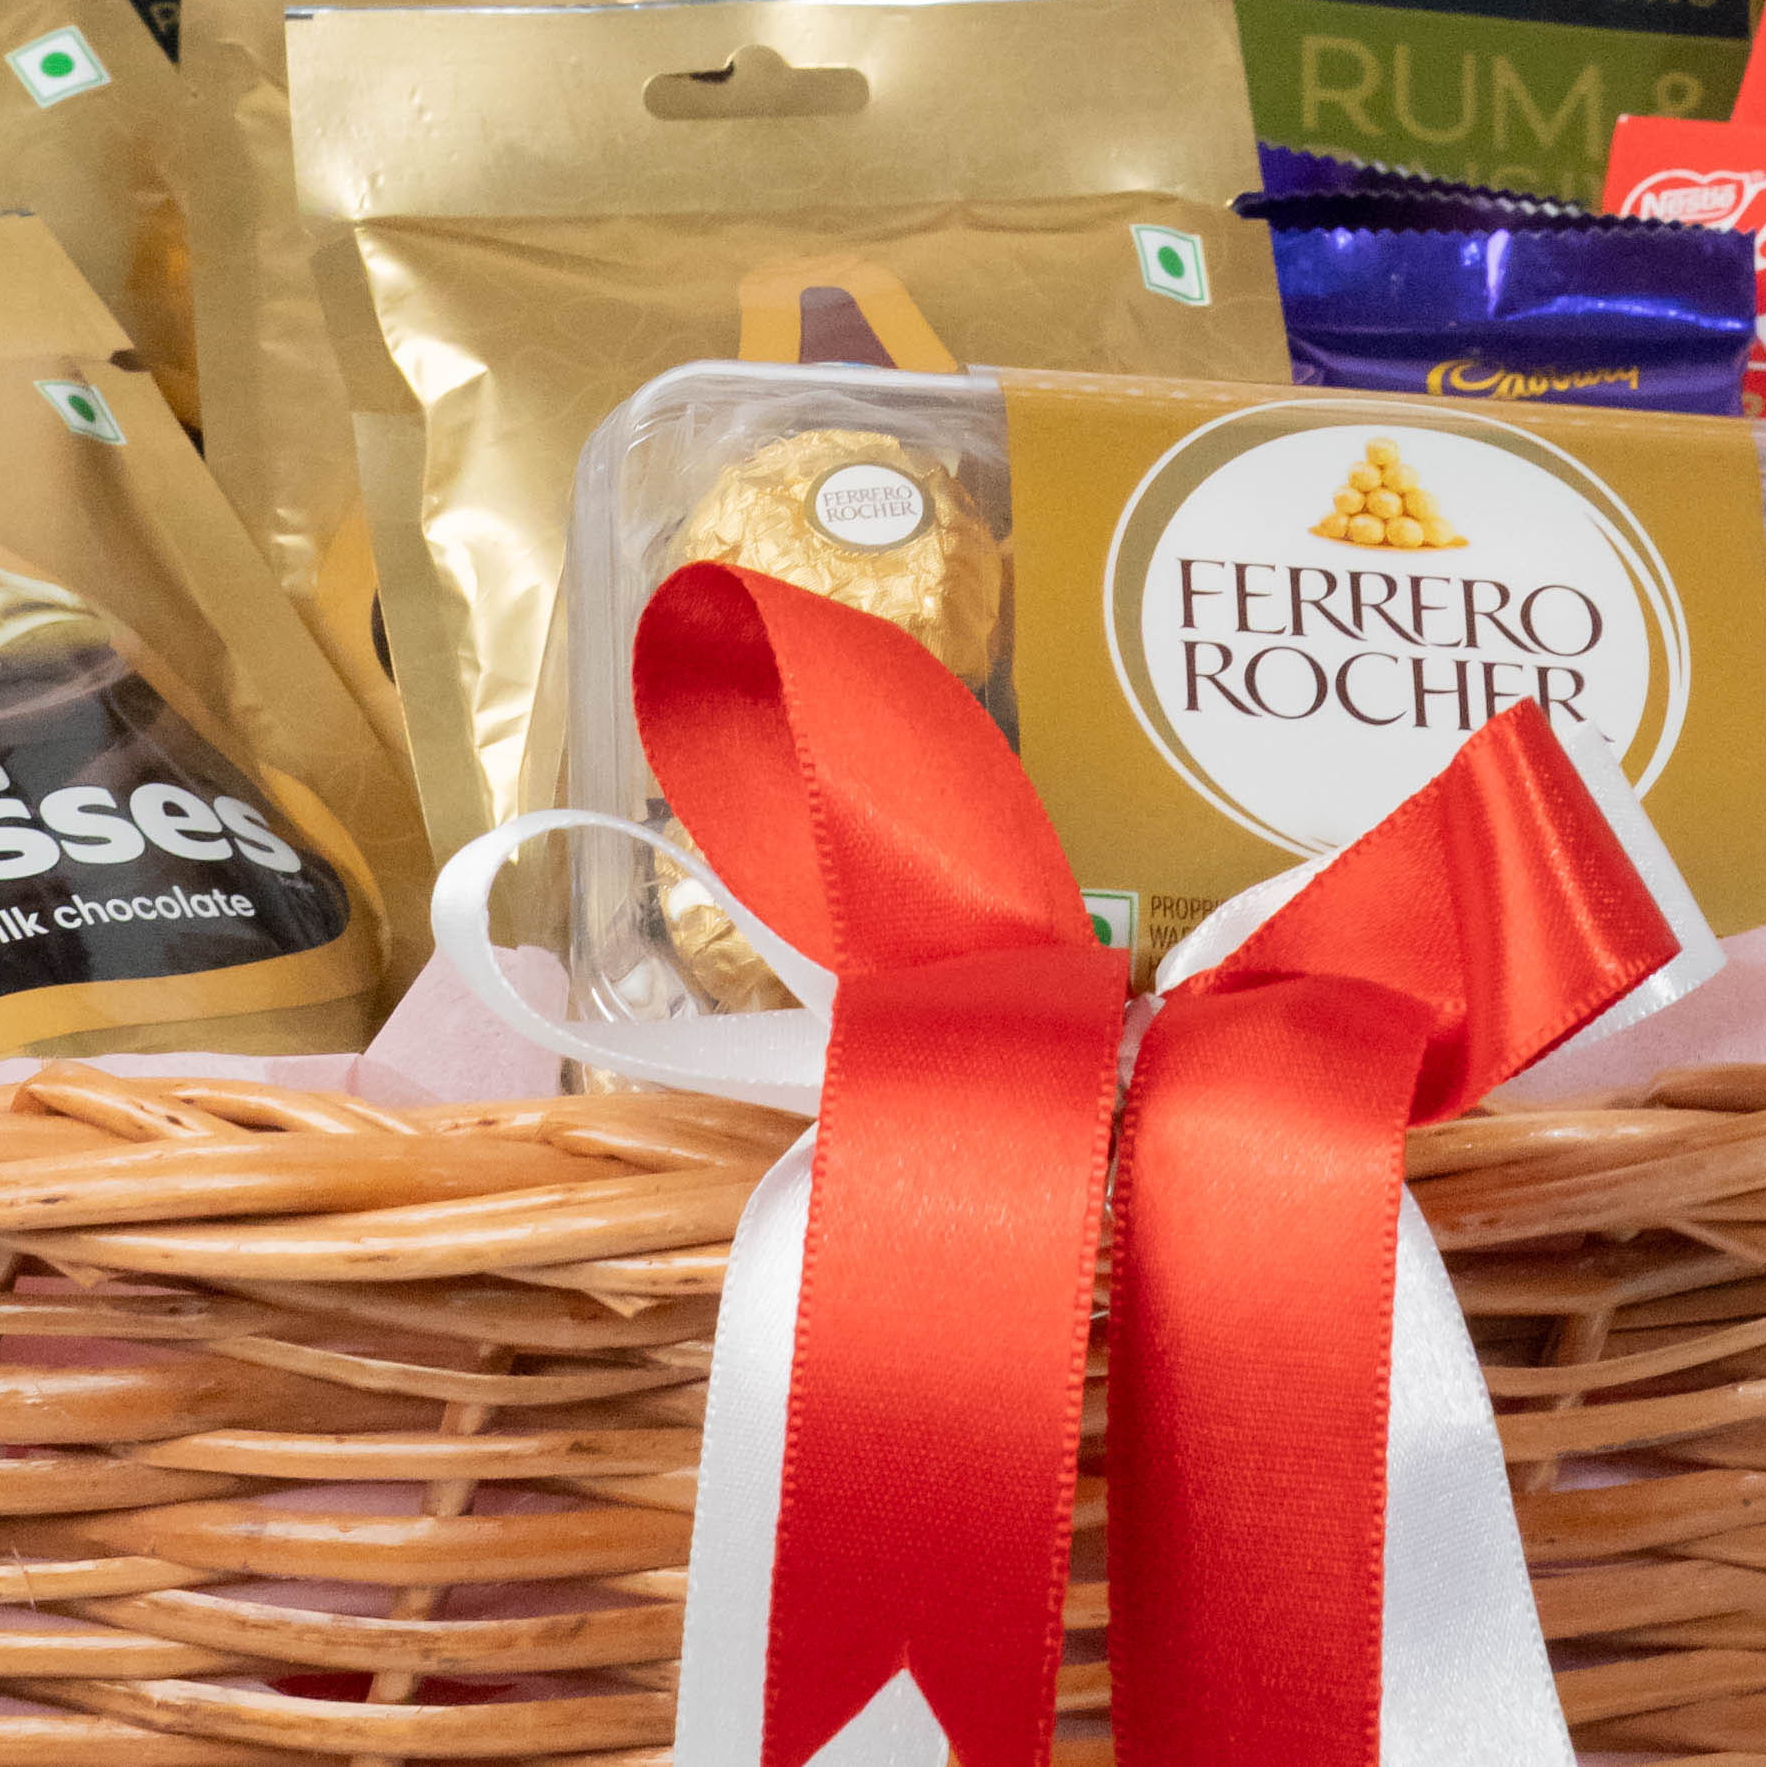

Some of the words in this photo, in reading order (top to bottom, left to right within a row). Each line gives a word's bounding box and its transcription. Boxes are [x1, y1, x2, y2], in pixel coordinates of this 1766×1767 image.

[1300, 35, 1604, 161] RUM
[823, 485, 913, 507] FERRERO
[826, 501, 918, 523] ROCHER
[1178, 557, 1603, 656] FERRERO
[1181, 638, 1615, 743] ROCHER
[53, 887, 255, 931] chocolate
